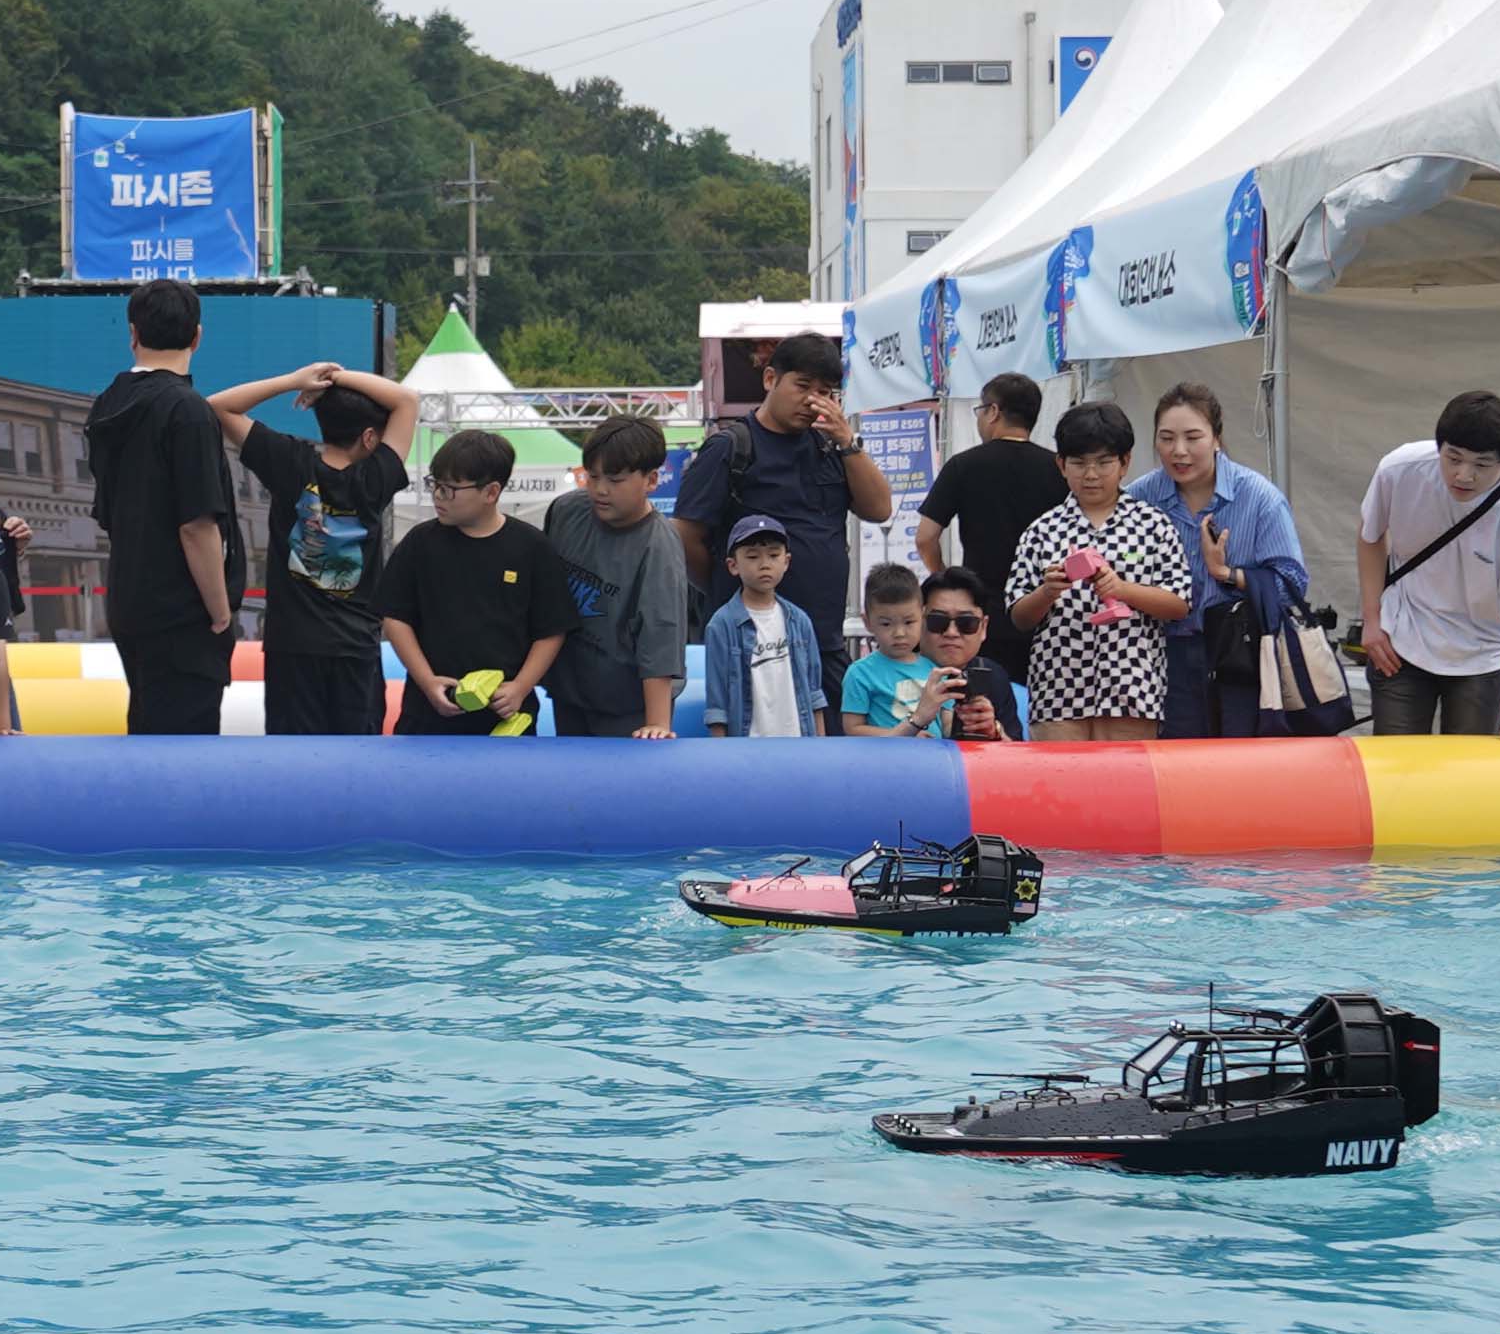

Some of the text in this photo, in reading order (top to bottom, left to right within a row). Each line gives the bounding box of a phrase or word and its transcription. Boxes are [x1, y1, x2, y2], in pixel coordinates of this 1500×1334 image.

[111, 170, 213, 207] 파시존
[131, 238, 194, 262] 파시를
[1118, 249, 1176, 307] 대회안내소
[1325, 1138, 1395, 1168] NAVY
